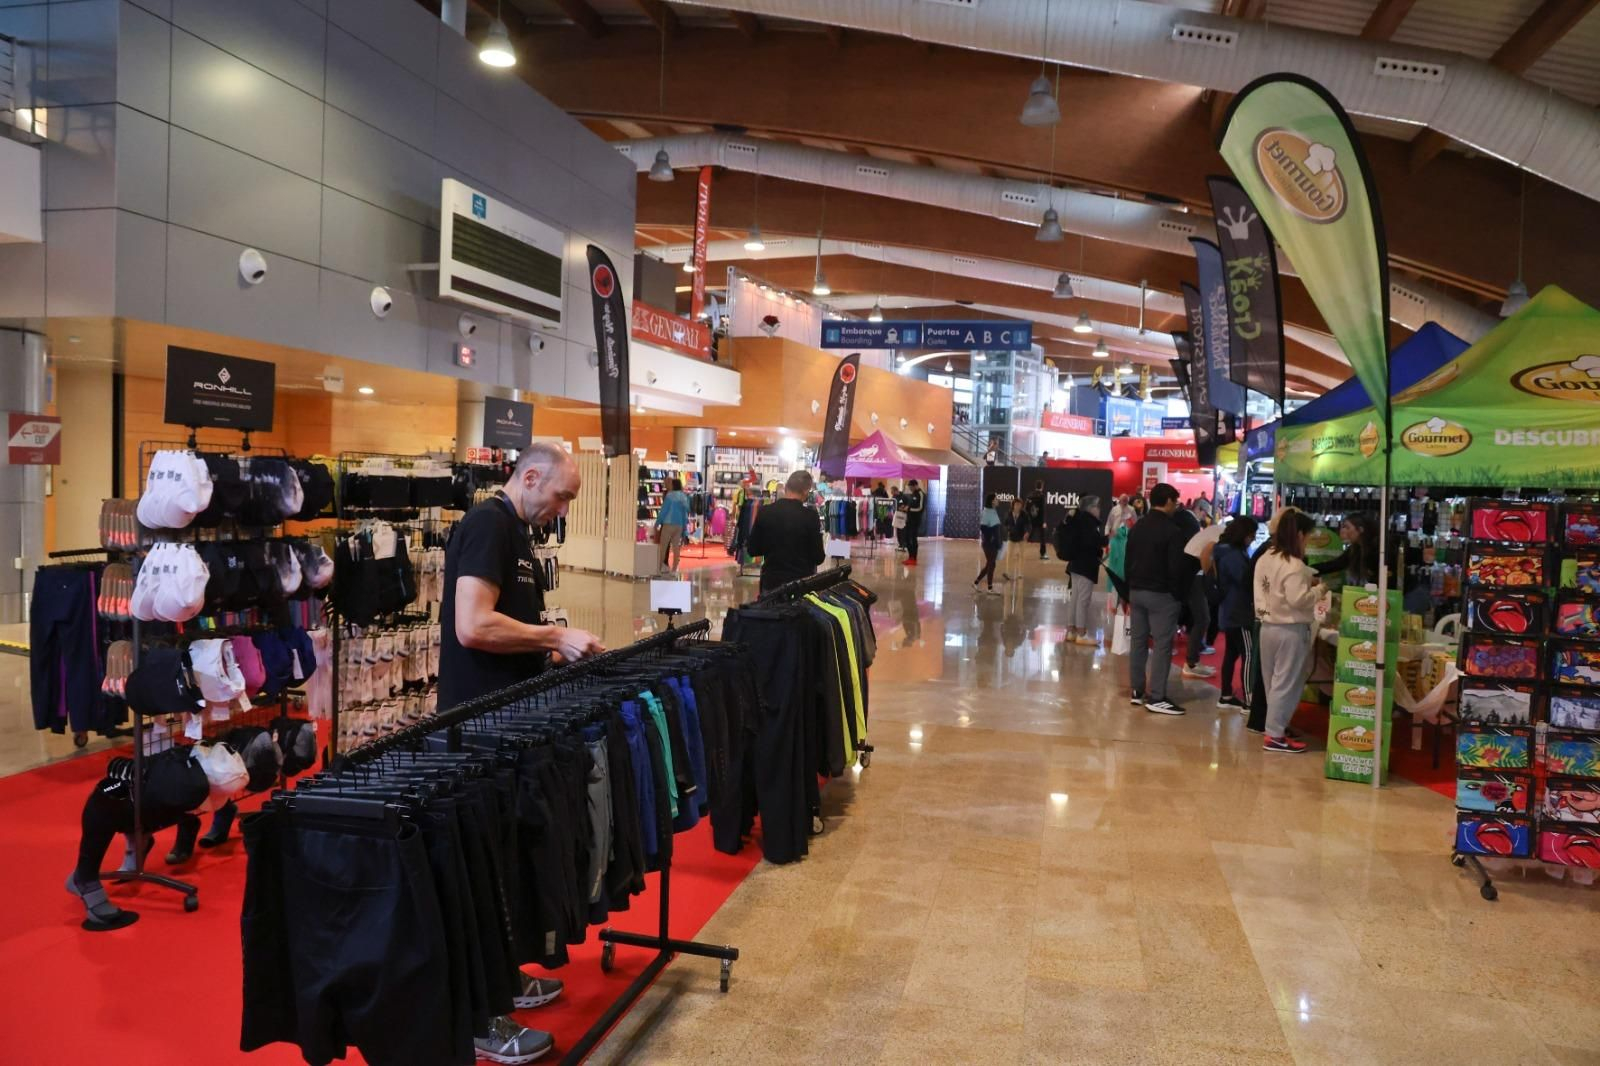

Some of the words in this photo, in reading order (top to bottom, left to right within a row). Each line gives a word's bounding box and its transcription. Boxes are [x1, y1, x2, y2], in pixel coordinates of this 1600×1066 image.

[696, 181, 709, 272] GENERALI
[649, 312, 699, 349] GENERALI
[841, 327, 882, 336] Embarque
[927, 327, 960, 336] Puertas
[841, 337, 872, 345] Boarding
[964, 330, 976, 343] A
[983, 331, 992, 344] B
[1000, 330, 1010, 344] C
[193, 381, 252, 396] RONHILL
[1408, 432, 1464, 444] Gourmet
[1158, 448, 1196, 458] GENERALI
[995, 492, 1015, 500] atlón
[1047, 491, 1080, 505] triatl
[1340, 734, 1375, 744] Gourme
